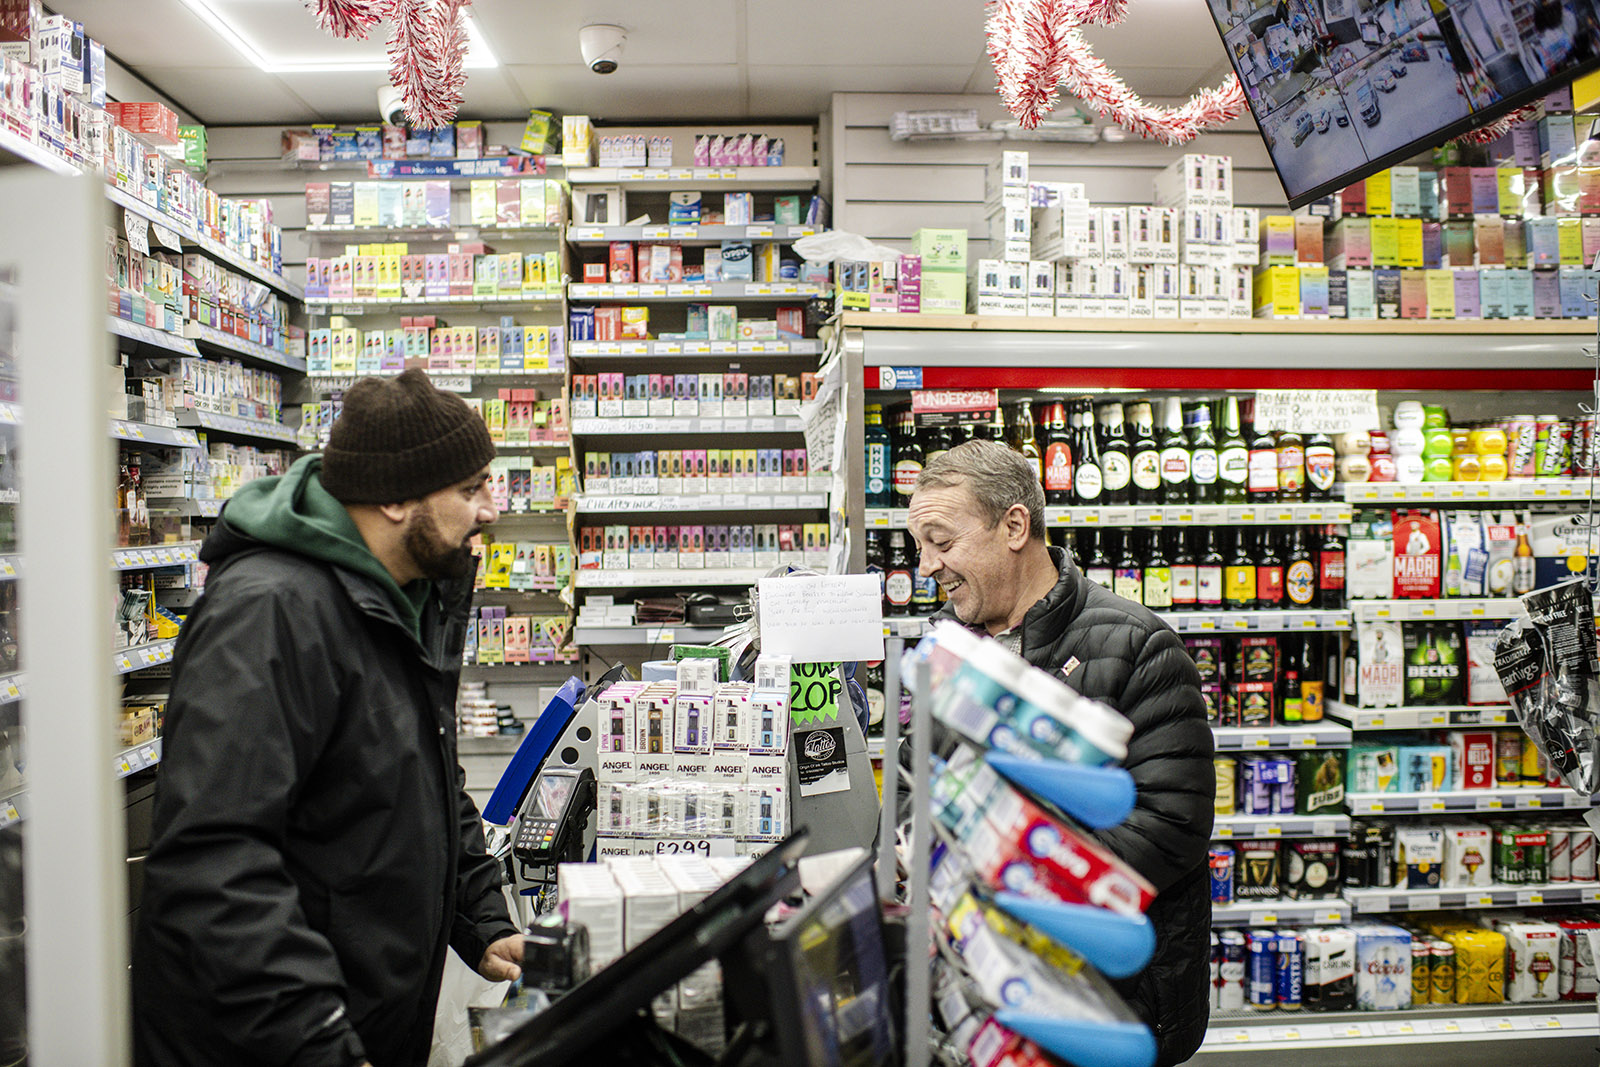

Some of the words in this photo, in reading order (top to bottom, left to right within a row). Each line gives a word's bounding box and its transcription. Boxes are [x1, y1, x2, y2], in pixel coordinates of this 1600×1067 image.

[1258, 393, 1271, 403] DO
[1333, 407, 1348, 416] YOU
[872, 447, 881, 475] WKD
[1408, 665, 1459, 677] BECK'S
[602, 761, 631, 769] ANGEL
[752, 766, 782, 774] ANGEL
[1367, 961, 1404, 975] Coors
